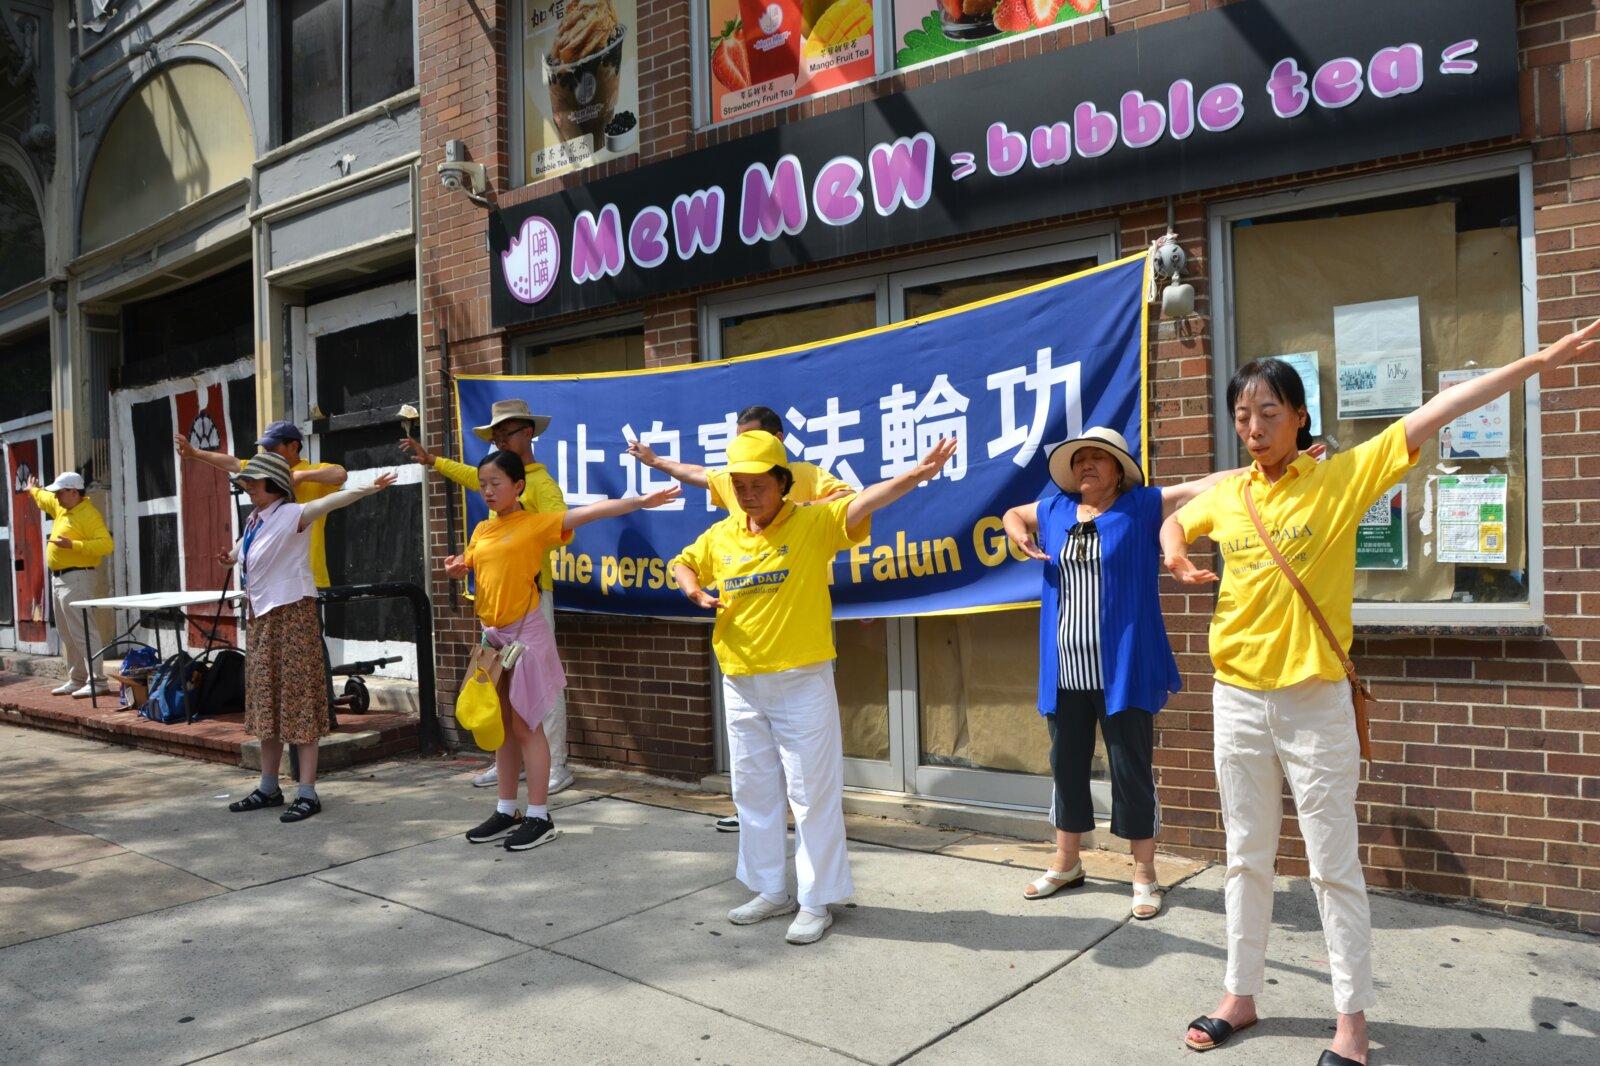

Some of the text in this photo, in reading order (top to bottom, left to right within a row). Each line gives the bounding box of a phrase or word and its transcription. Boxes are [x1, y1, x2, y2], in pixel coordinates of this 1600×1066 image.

[809, 59, 835, 72] Mango
[835, 53, 853, 64] Fruit
[855, 48, 869, 59] Tea
[723, 97, 761, 115] Strawberry
[762, 93, 778, 104] Fruit
[779, 89, 793, 99] Tea
[535, 152, 590, 175] Bubble Tea Bingsu
[571, 42, 1423, 285] Mew Mew bubble tea
[550, 549, 593, 583] the
[851, 530, 962, 583] Falun
[757, 572, 786, 584] DAFA
